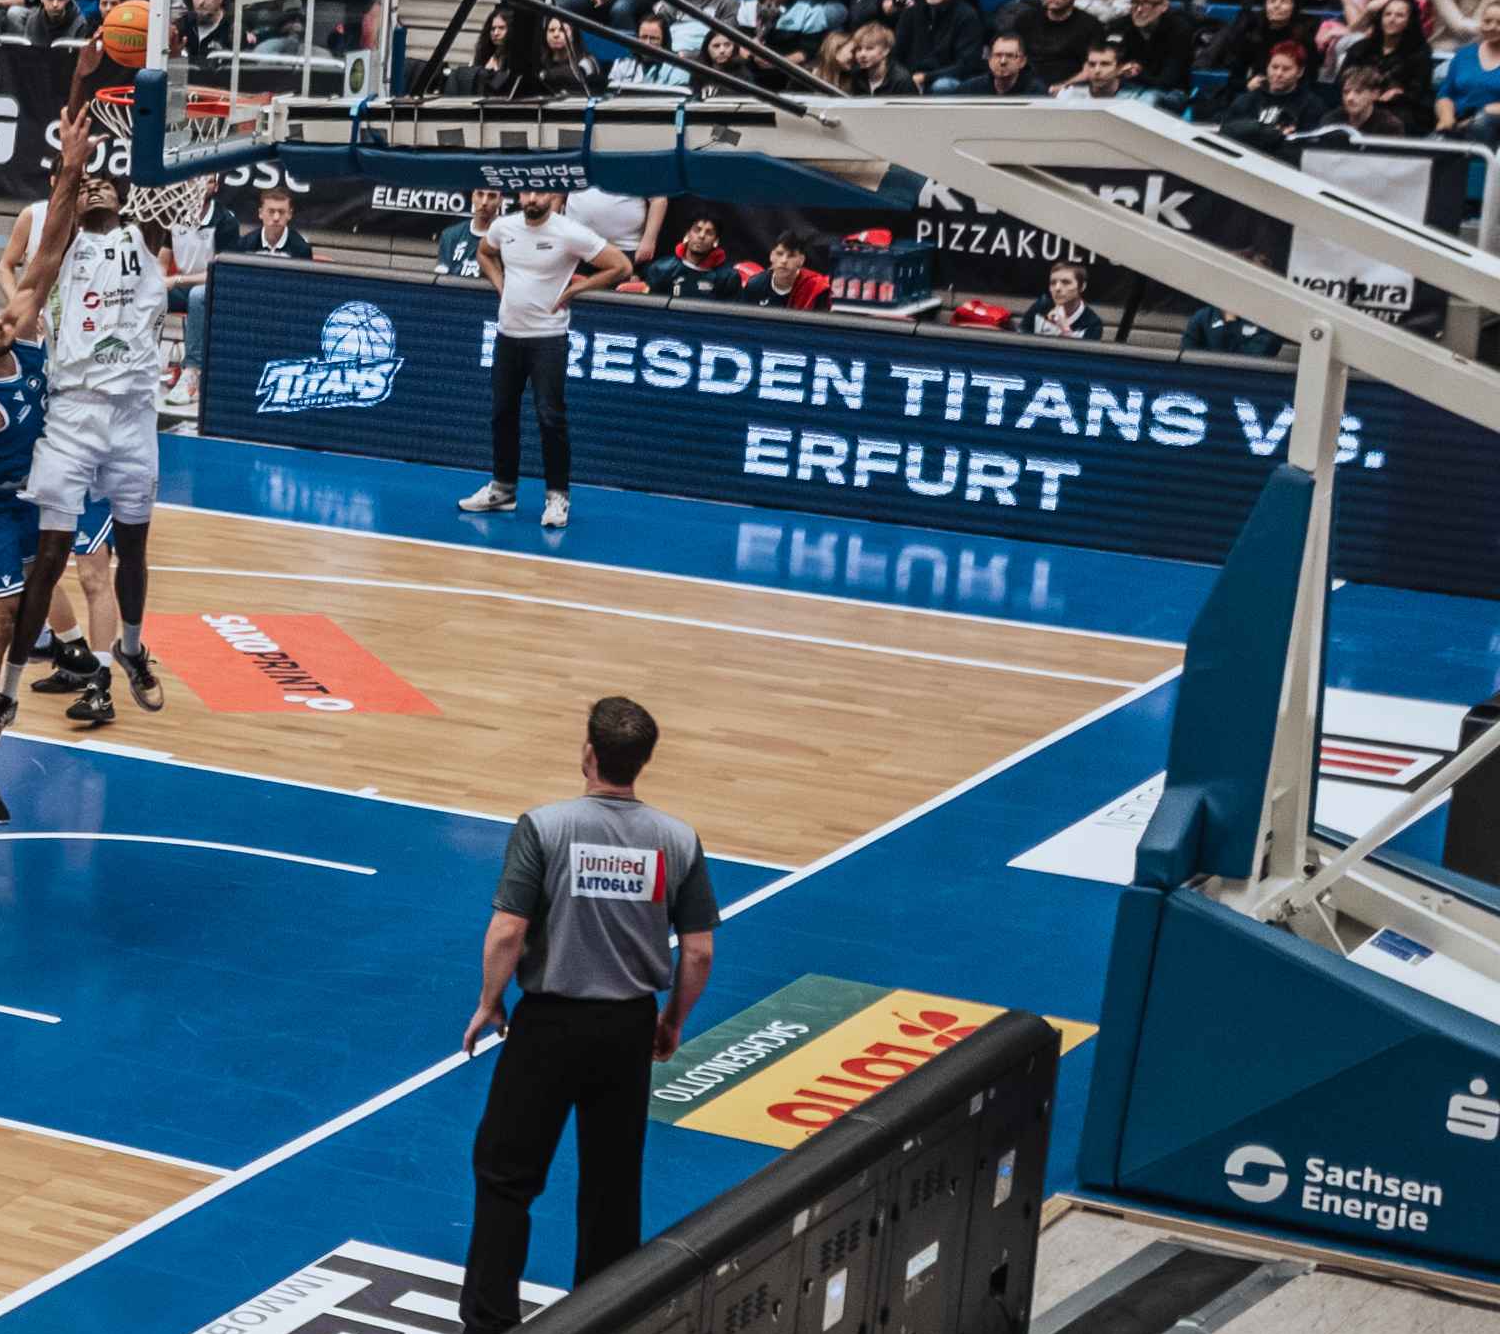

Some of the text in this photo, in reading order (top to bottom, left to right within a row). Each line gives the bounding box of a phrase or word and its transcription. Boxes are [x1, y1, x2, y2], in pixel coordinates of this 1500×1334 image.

[480, 164, 586, 178] Schelde
[487, 176, 589, 190] Sports
[371, 185, 465, 214] ELEKTRO
[120, 249, 142, 277] 14
[94, 352, 132, 365] GWG
[265, 357, 398, 402] TITANS
[889, 362, 1210, 448] TITANS
[743, 423, 1083, 512] ERFURT
[200, 613, 332, 694] SAXOPRINT
[577, 850, 647, 877] junited
[577, 875, 645, 894] AUTOGLAS
[652, 1020, 810, 1103] SACHSENLOTTO
[1303, 1155, 1444, 1208] Sachsen
[1300, 1184, 1430, 1234] Energie
